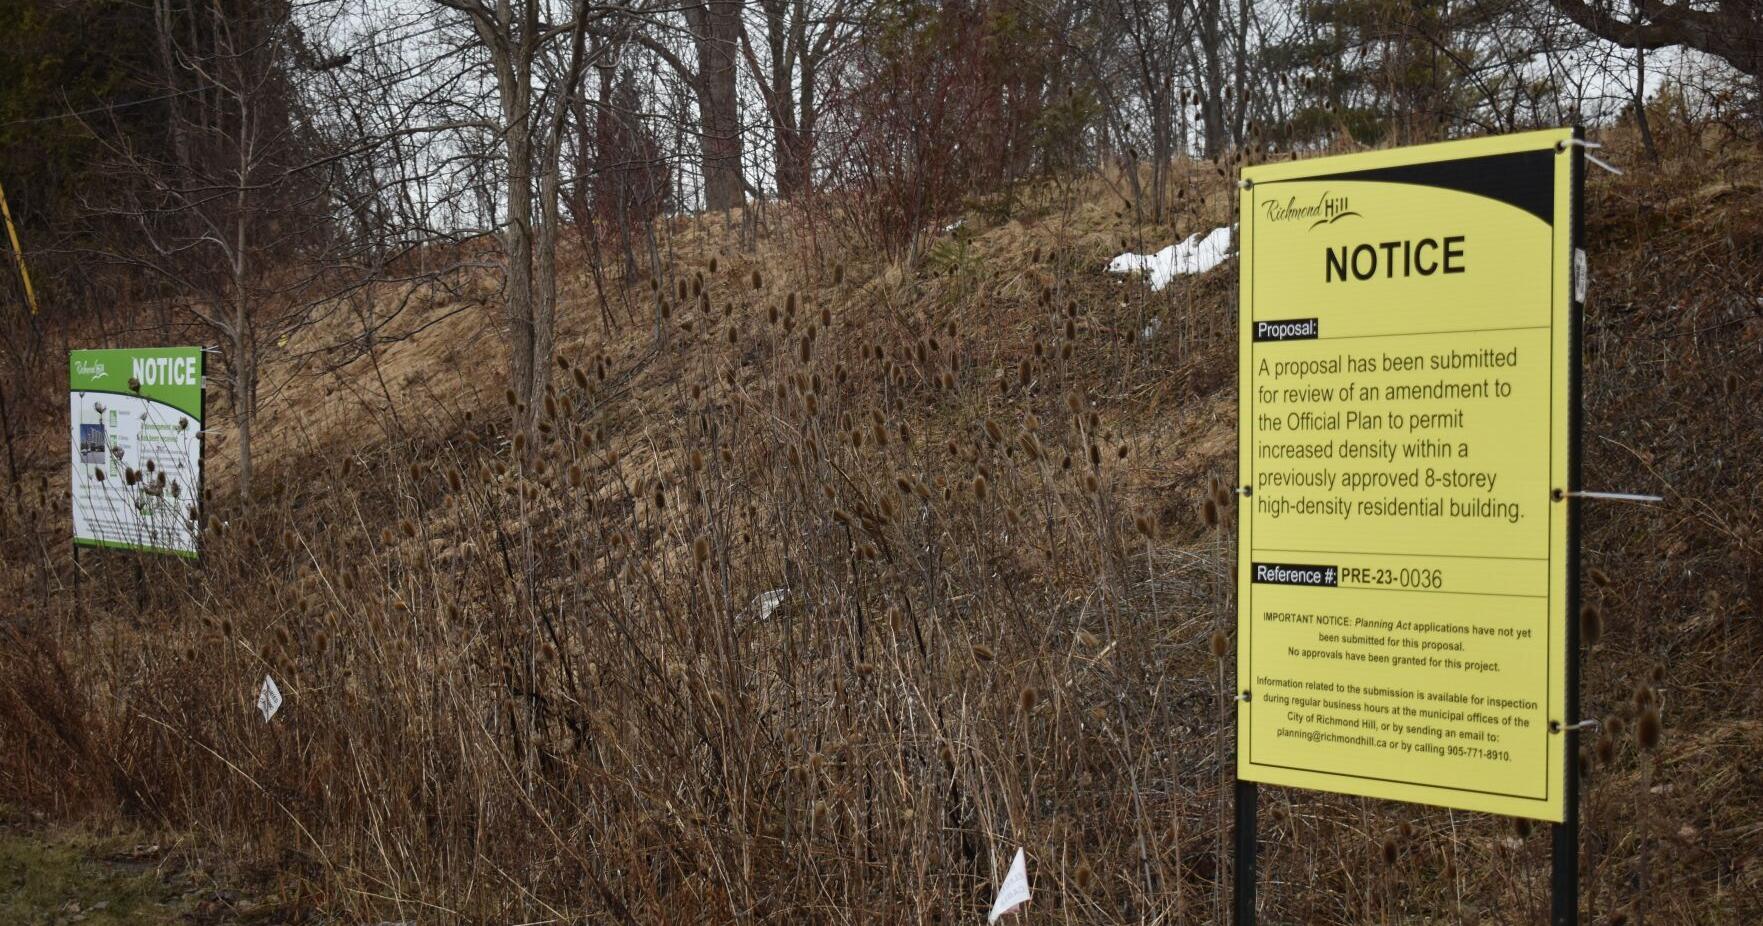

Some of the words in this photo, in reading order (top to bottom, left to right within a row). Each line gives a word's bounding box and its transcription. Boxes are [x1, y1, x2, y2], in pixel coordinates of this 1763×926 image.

[1261, 191, 1328, 221] Richmond
[1324, 197, 1348, 216] Hill
[1325, 235, 1465, 283] NOTICE
[1258, 321, 1317, 339] Proposal:
[132, 357, 196, 386] NOTICE
[1258, 359, 1270, 377] A
[1274, 354, 1342, 379] proposal
[1347, 353, 1377, 373] has
[1382, 352, 1424, 371] been
[1430, 348, 1517, 369] submitted
[1258, 386, 1278, 403] for
[1283, 385, 1333, 402] review
[1338, 383, 1355, 401] of
[1359, 384, 1379, 400] an
[1385, 379, 1488, 399] amendment
[1494, 380, 1511, 397] to
[1258, 414, 1282, 432] the
[1287, 411, 1340, 431] Official
[1346, 411, 1382, 430] Plan
[1387, 413, 1403, 429] to
[1409, 409, 1463, 434] permit
[1258, 441, 1333, 460] increased
[1338, 440, 1397, 463] density
[1402, 440, 1452, 458] within
[1458, 443, 1468, 457] a
[1258, 468, 1337, 491] previously
[1341, 468, 1419, 491] approved
[1425, 468, 1497, 491] 8-storey
[1258, 497, 1352, 519] high-density
[1357, 497, 1444, 517] residential
[1450, 498, 1524, 523] building.
[1257, 566, 1322, 583] Reference
[1324, 569, 1336, 584] #:
[1263, 612, 1313, 624] IMPORTANT
[1316, 616, 1352, 627] NOTICE:
[1355, 618, 1393, 631] Planning
[1396, 620, 1412, 630] Act
[1413, 621, 1469, 635] applications
[1472, 624, 1494, 636] have
[1498, 628, 1513, 637] not
[1516, 628, 1532, 639] yet
[1319, 632, 1339, 642] been
[1341, 634, 1384, 646] submitted
[1387, 637, 1400, 647] for
[1402, 638, 1419, 648] this
[1421, 639, 1464, 652] proposal.
[1288, 647, 1299, 656] No
[1301, 648, 1343, 661] approvals
[1346, 651, 1366, 662] have
[1368, 652, 1389, 664] been
[1392, 654, 1426, 668] granted
[1429, 656, 1442, 666] for
[1444, 658, 1462, 669] this
[1464, 659, 1500, 673] project.
[1256, 676, 1302, 689] Information
[1305, 680, 1334, 692] related
[1336, 682, 1345, 692] to
[1347, 683, 1361, 694] the
[1363, 684, 1414, 699] submission
[1416, 689, 1424, 699] is
[1427, 690, 1469, 702] available
[1471, 693, 1484, 704] for
[1487, 695, 1538, 711] inspection
[1263, 693, 1289, 706] during
[1291, 696, 1321, 709] regular
[1323, 699, 1362, 712] business
[1364, 702, 1389, 715] hours
[1391, 706, 1401, 716] at
[1402, 706, 1417, 717] the
[1419, 707, 1464, 722] municipal
[1466, 712, 1499, 726] offices
[1501, 715, 1512, 726] of
[1514, 716, 1529, 728] the
[1288, 711, 1304, 724] City
[1306, 714, 1314, 724] of
[1316, 714, 1359, 728] Richmond
[1362, 718, 1379, 731] Hill,
[1381, 722, 1391, 731] or
[1392, 722, 1404, 734] by
[1406, 723, 1442, 738] sending
[1445, 728, 1456, 739] an
[1459, 728, 1484, 741] email
[1486, 731, 1499, 742] to:
[1277, 727, 1388, 748] planning@richmondhill.ca
[1389, 739, 1399, 749] or
[1401, 739, 1412, 751] by
[1414, 740, 1445, 756] calling
[1447, 744, 1512, 762] 905-771-8910.
